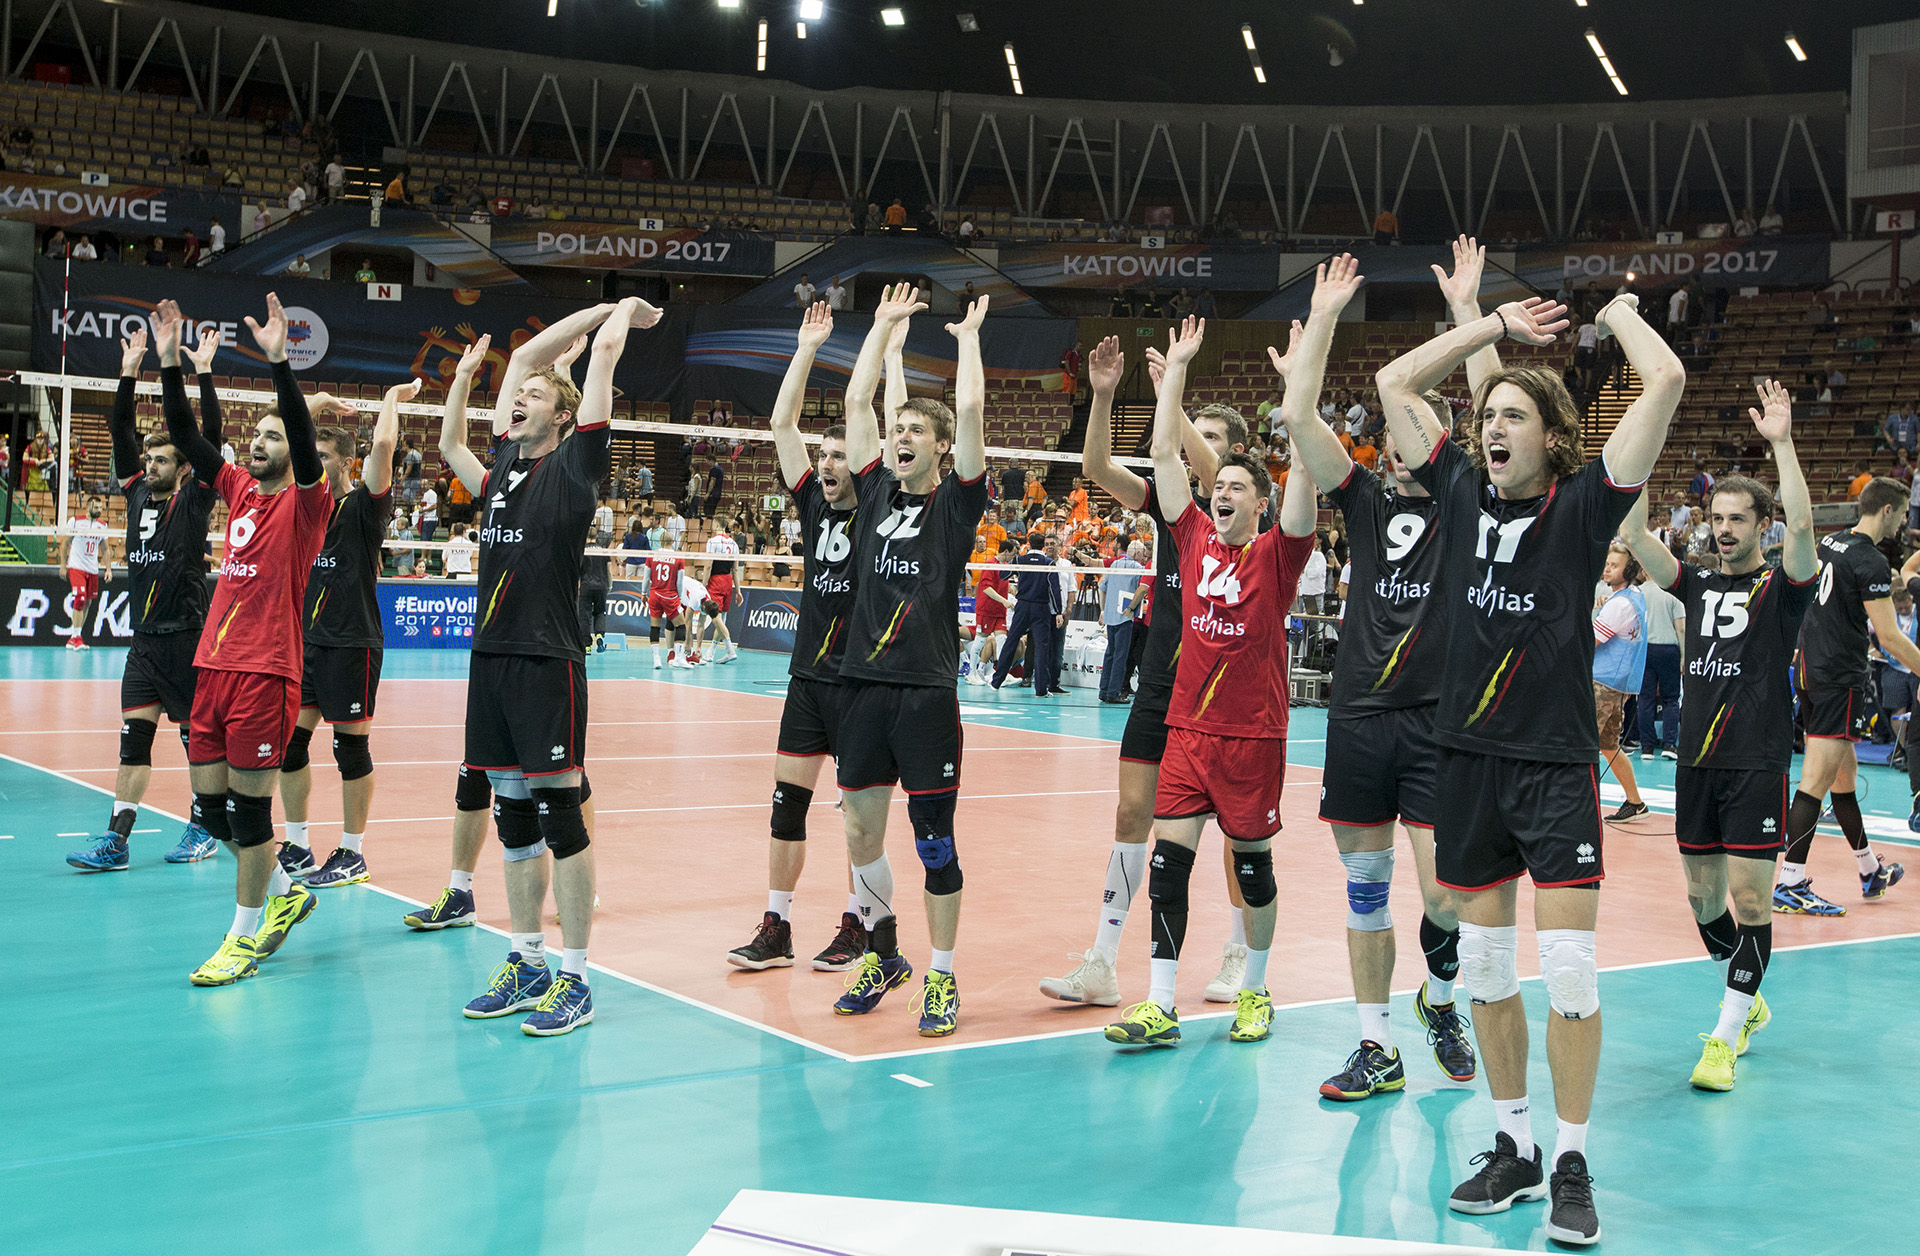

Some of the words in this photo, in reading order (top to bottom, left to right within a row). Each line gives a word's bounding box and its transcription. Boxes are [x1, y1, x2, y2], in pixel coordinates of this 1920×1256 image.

[90, 173, 100, 184] P
[0, 185, 168, 223] KATOWICE
[646, 219, 656, 230] R
[1887, 213, 1903, 229] R
[537, 232, 659, 259] POLAND
[664, 240, 732, 262] 2017
[1147, 237, 1158, 248] S
[1664, 233, 1675, 244] T
[1063, 254, 1213, 277] KATOWICE
[1563, 252, 1696, 277] POLAND
[1702, 250, 1779, 274] 2017
[377, 285, 392, 299] N
[139, 508, 159, 540] 5
[229, 508, 257, 547] 6
[876, 505, 924, 540] 12
[1475, 507, 1537, 563] 11
[85, 541, 96, 553] 10
[814, 518, 851, 562] 16
[1386, 513, 1426, 562] 9
[129, 540, 166, 567] ethias
[655, 563, 670, 581] 13
[1196, 554, 1242, 605] 14
[394, 596, 478, 613] #EuroVoll
[1700, 588, 1749, 639] 15
[395, 615, 440, 626] 2017
[446, 615, 475, 626] POL
[747, 609, 800, 631] KATOWIC
[1190, 601, 1246, 640] ethias
[1689, 642, 1742, 682] ethias
